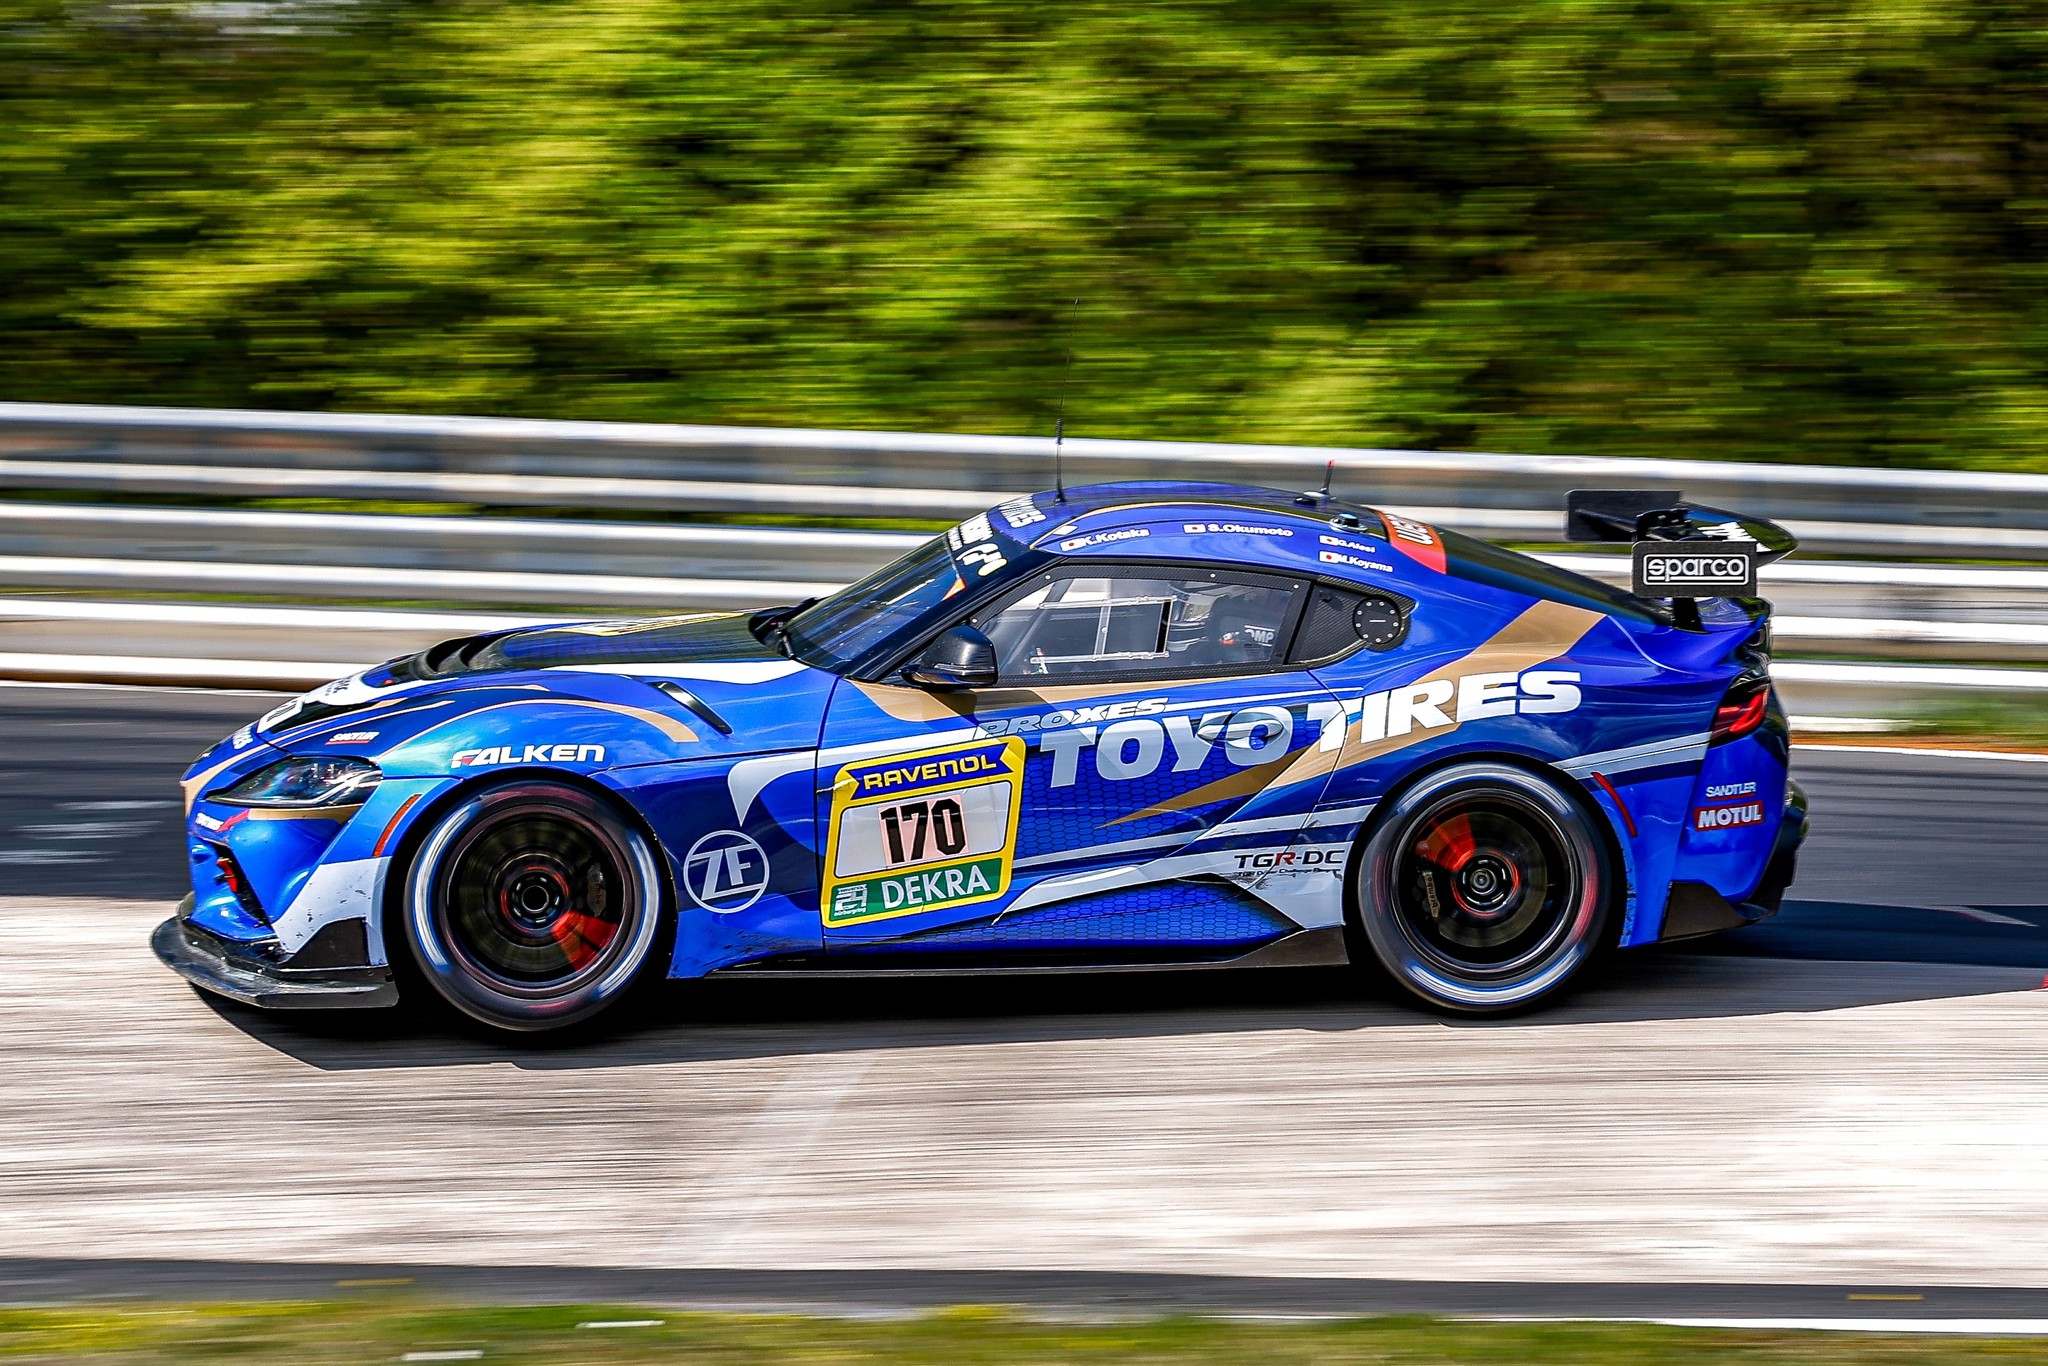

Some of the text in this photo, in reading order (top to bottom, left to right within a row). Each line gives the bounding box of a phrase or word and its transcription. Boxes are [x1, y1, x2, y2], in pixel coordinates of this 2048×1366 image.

[1082, 529, 1150, 547] K.Kotaka
[1207, 523, 1294, 537] S.Okumoto
[1648, 556, 1745, 583] sparco
[973, 697, 1169, 741] PROXES
[1039, 671, 1582, 788] TOYO TIRES
[451, 743, 605, 769] FALKEN
[864, 754, 997, 789] RAVENOL
[1706, 782, 1757, 797] SANDTLER
[1698, 804, 1762, 828] MOTUL
[879, 798, 968, 864] 170
[687, 842, 766, 901] ZF
[1234, 850, 1345, 868] TGR-DC
[881, 865, 991, 909] DEKRA
